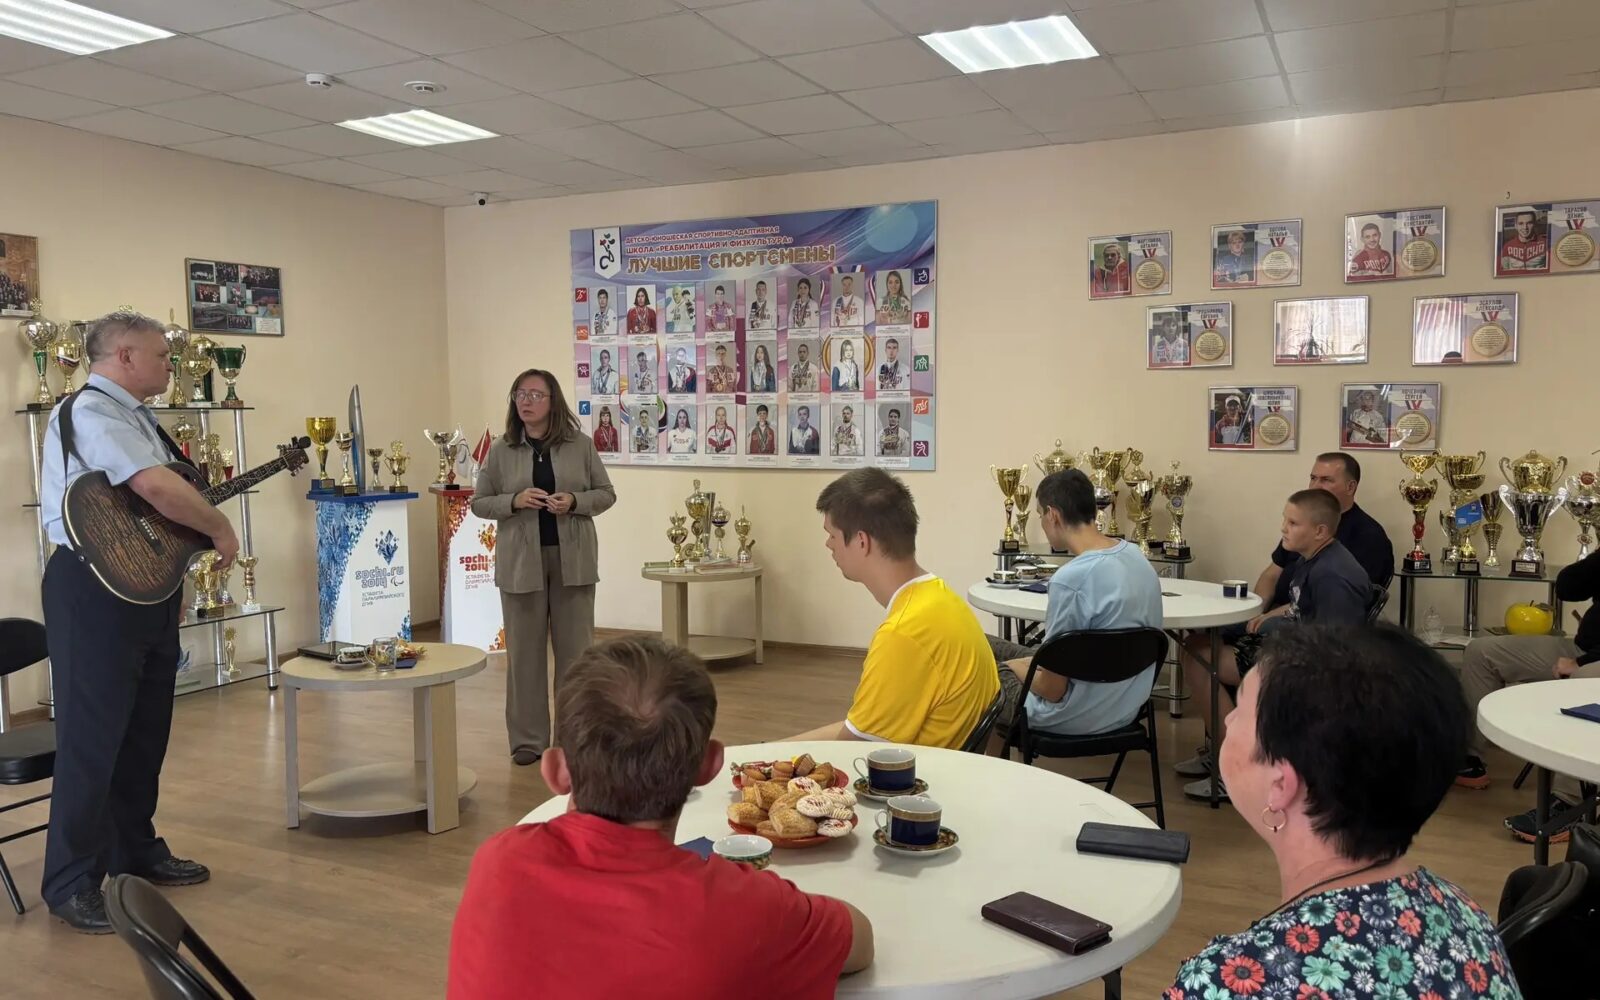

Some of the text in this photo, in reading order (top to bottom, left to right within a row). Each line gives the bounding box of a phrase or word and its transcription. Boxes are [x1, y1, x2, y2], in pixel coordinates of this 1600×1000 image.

[626, 226, 779, 243] ДЕТСКО-ЮНОШЕСКАЯ СПОРТИВНО-АДАПТИВНАЯ
[626, 236, 794, 254] ШКОЛА «РЕАБИЛИТАЦИЯ И ФИЗКУЛЬТУРА»
[627, 244, 836, 274] ЛУЧШИЕ СПОРТСМЕНЫ
